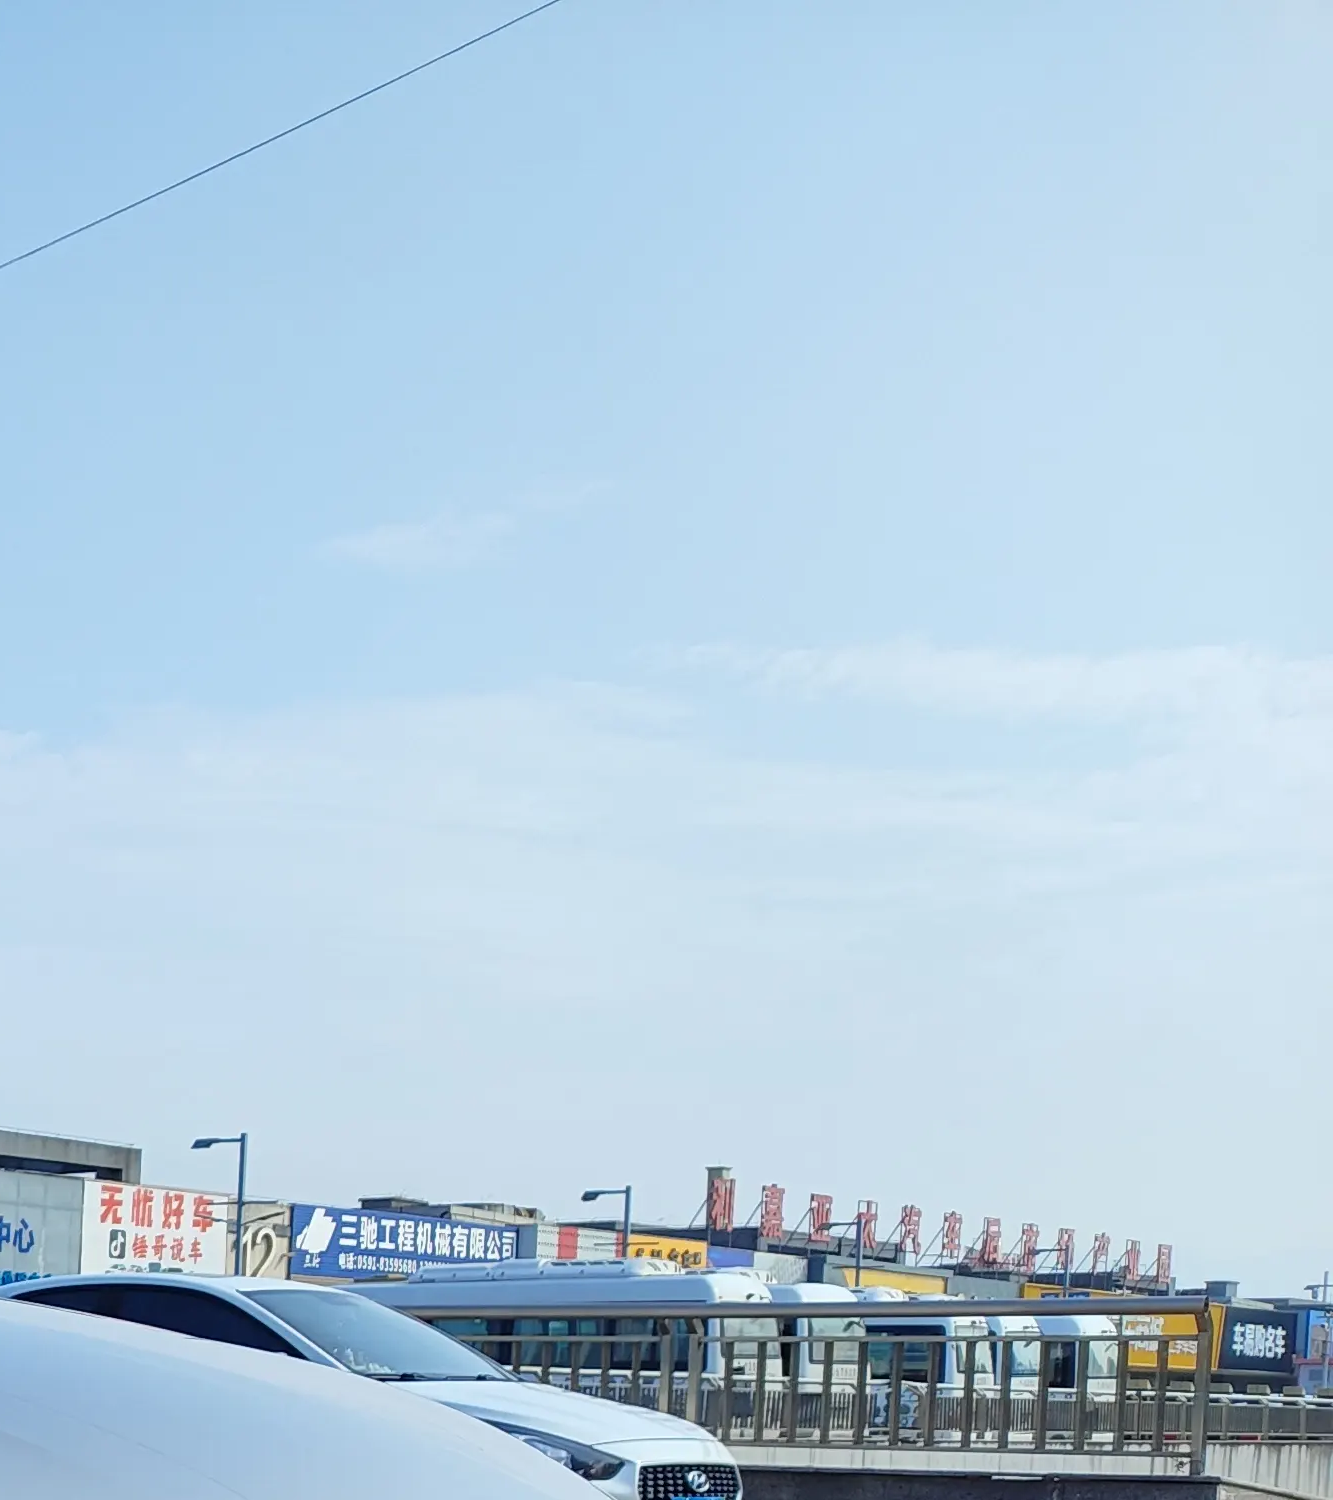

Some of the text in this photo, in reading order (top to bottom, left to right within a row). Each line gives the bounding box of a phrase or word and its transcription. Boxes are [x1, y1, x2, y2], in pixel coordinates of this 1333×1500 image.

[99, 1184, 216, 1233] 无忧好车
[242, 1225, 277, 1278] 12
[339, 1214, 517, 1261] 三驰工程机械有限公司
[1232, 1322, 1287, 1359] 车易购名车
